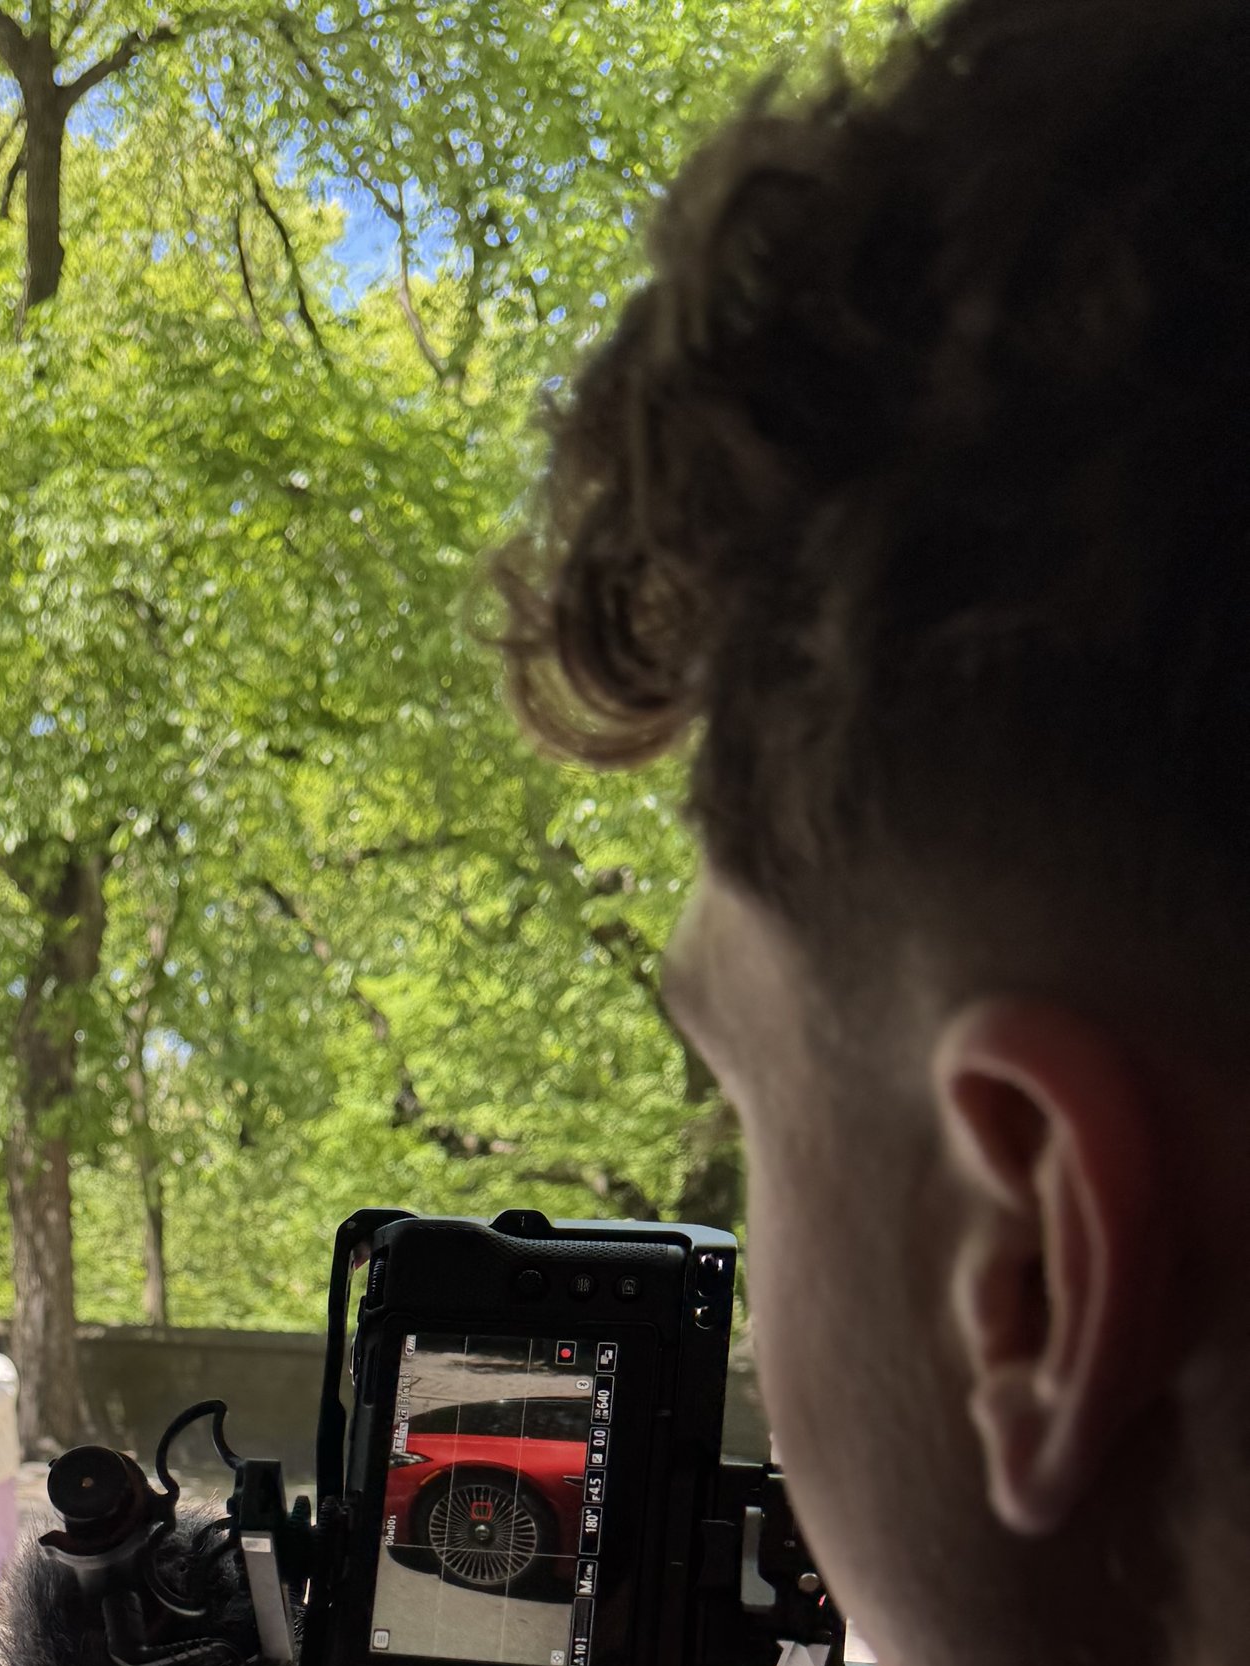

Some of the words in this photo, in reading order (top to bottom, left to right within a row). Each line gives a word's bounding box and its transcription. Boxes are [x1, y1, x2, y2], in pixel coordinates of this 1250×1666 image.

[597, 1389, 610, 1409] 640
[593, 1430, 606, 1446] 0.0
[589, 1478, 602, 1501] F4.5
[585, 1509, 598, 1533] 180°
[579, 1580, 593, 1593] M
